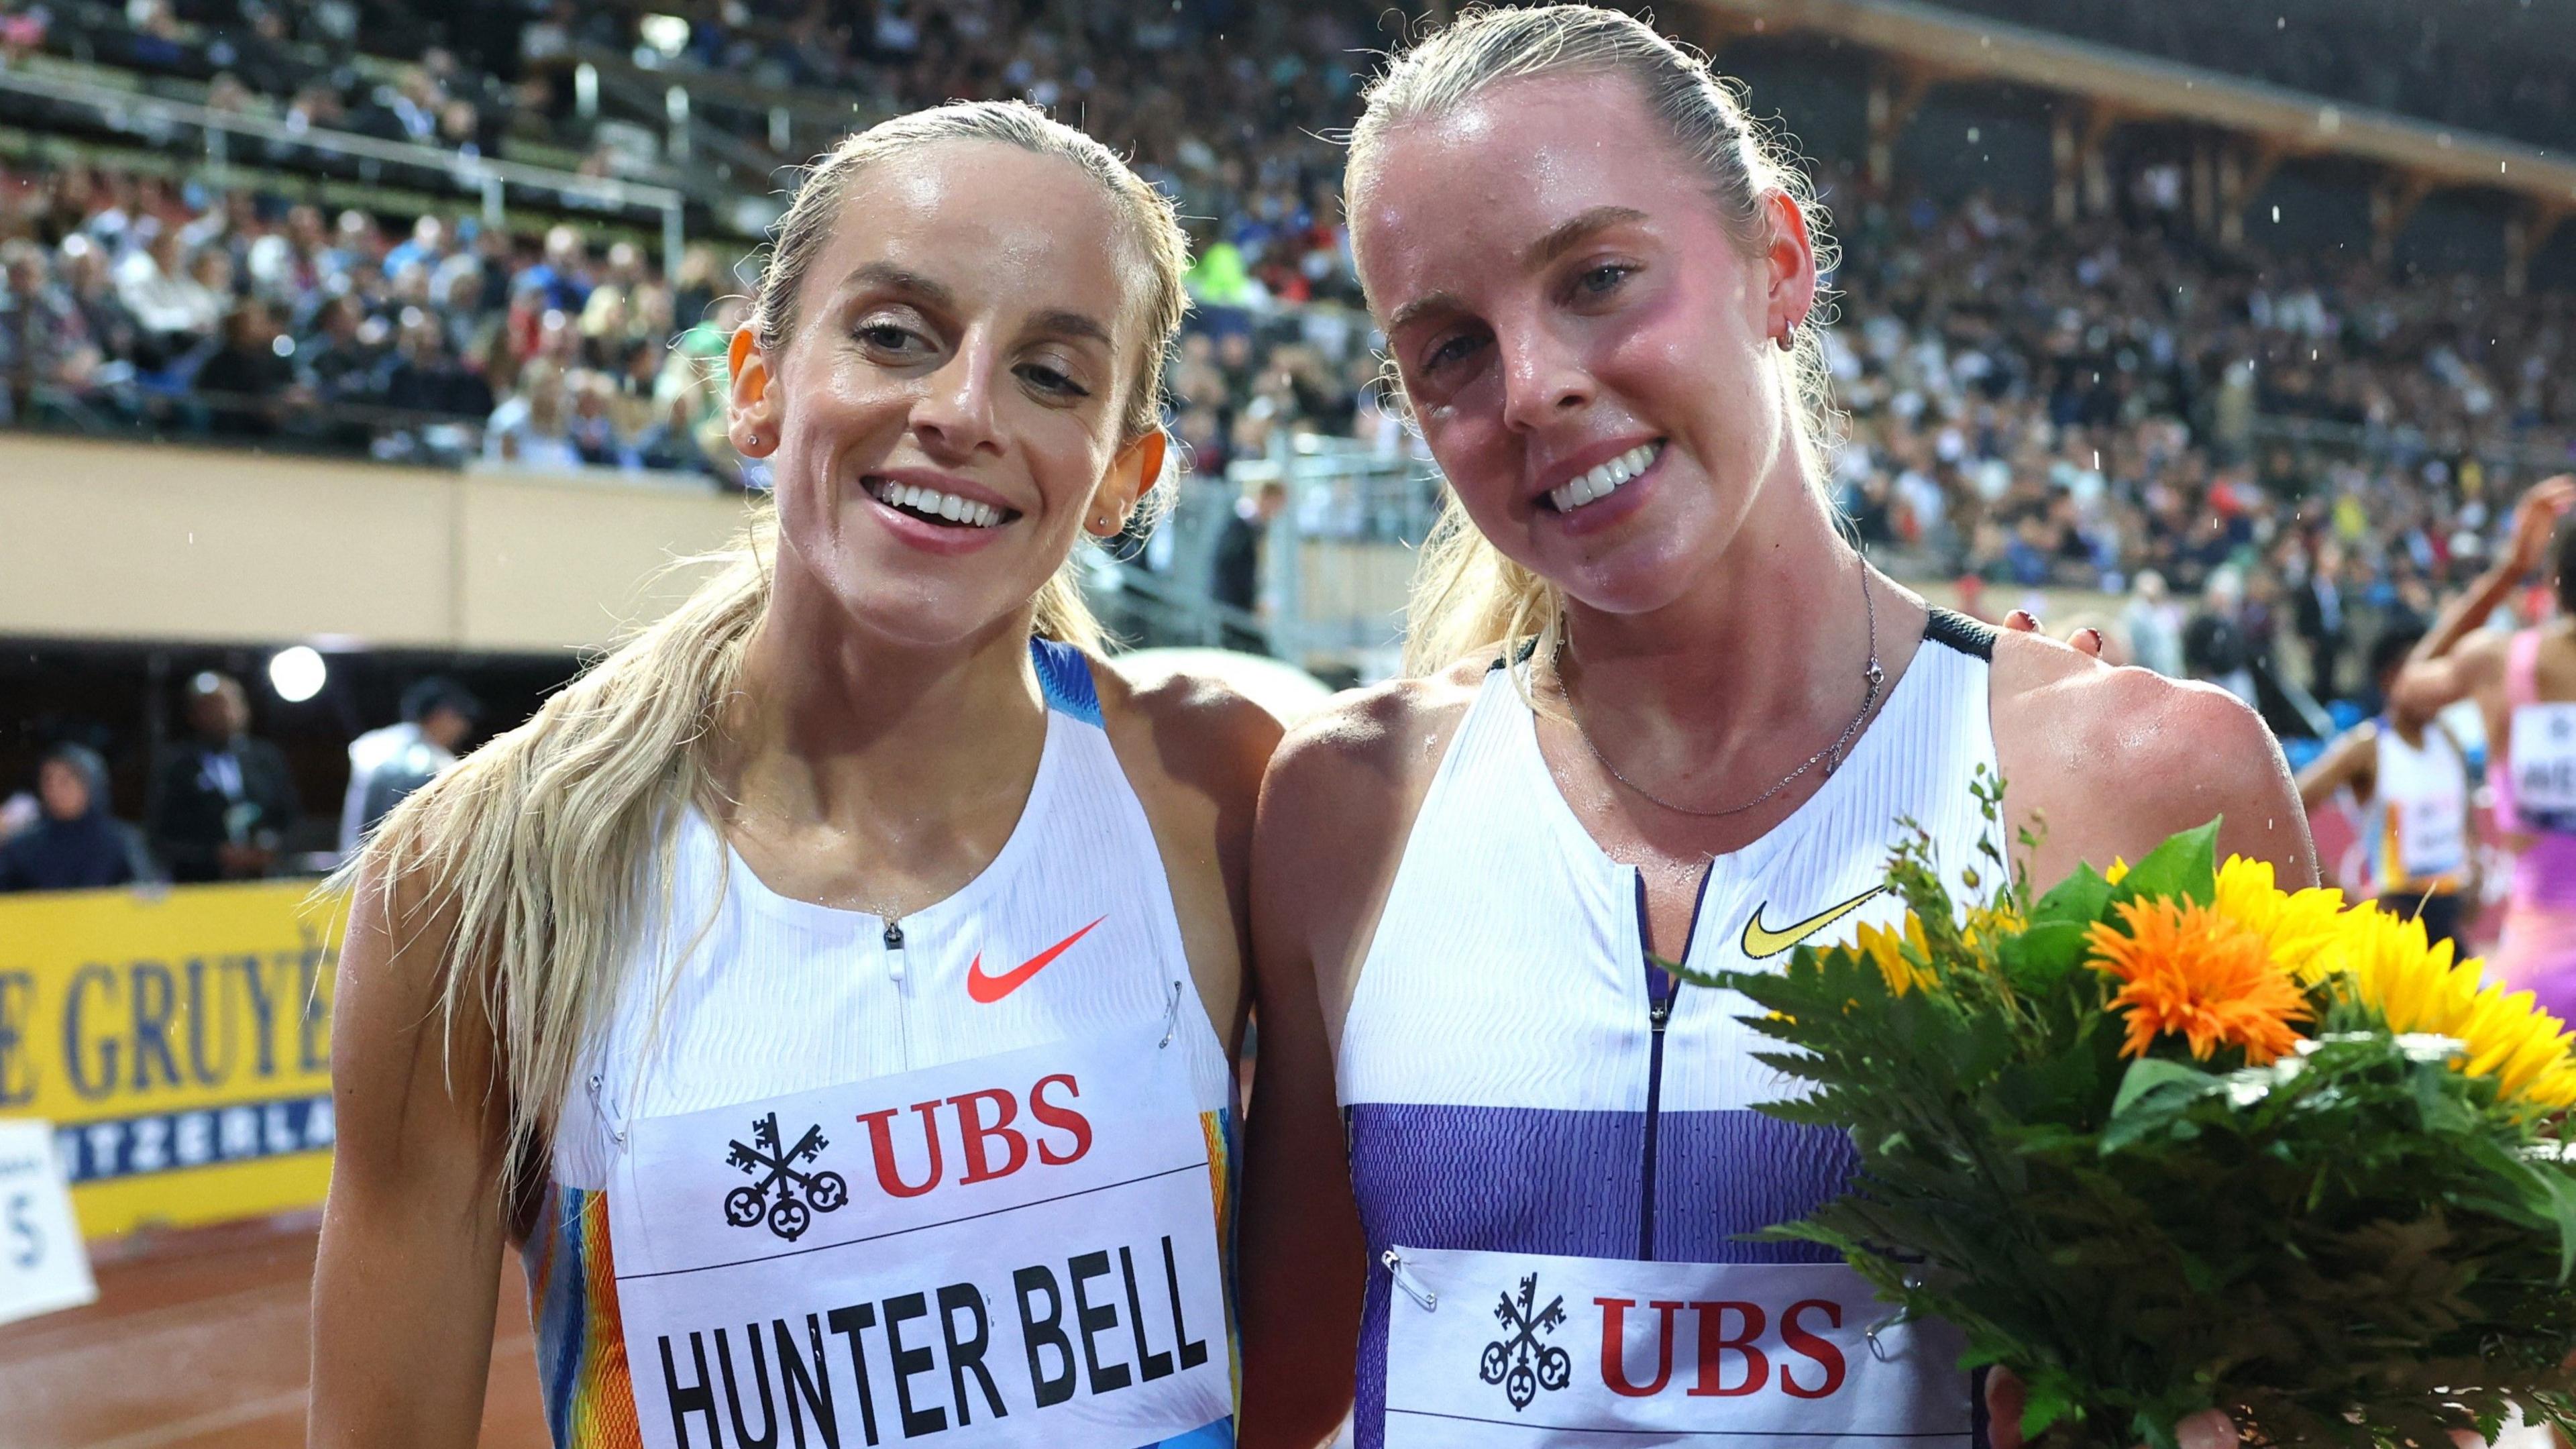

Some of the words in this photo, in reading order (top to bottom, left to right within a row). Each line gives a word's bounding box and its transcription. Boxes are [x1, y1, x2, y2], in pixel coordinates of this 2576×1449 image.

[857, 1073, 1093, 1199] UBS
[657, 1282, 1007, 1449] HUNTER
[1013, 1235, 1208, 1409] BELL
[1593, 1297, 1846, 1399] UBS
